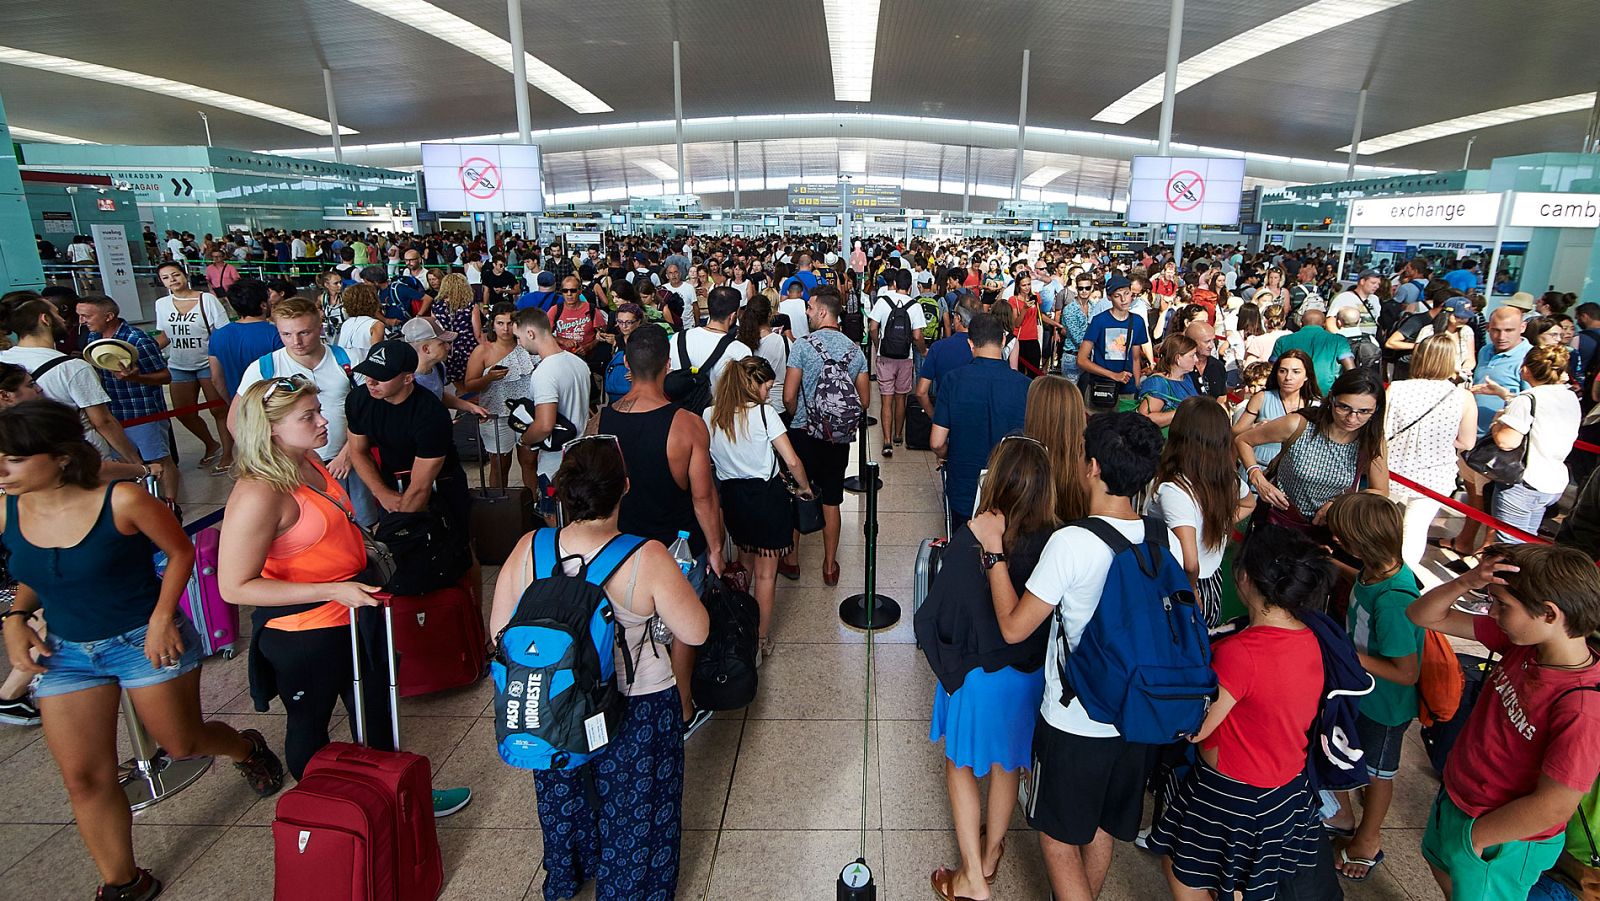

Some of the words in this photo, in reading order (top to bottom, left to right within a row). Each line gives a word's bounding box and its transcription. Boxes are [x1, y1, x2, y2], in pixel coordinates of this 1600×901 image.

[1390, 201, 1466, 221] exchange
[1540, 200, 1599, 218] camb
[1447, 242, 1465, 250] FREE
[168, 312, 199, 322] SAVE
[171, 324, 191, 336] THE
[168, 337, 202, 349] LANET
[525, 673, 542, 729] NOROESTE
[507, 700, 519, 729] PASO
